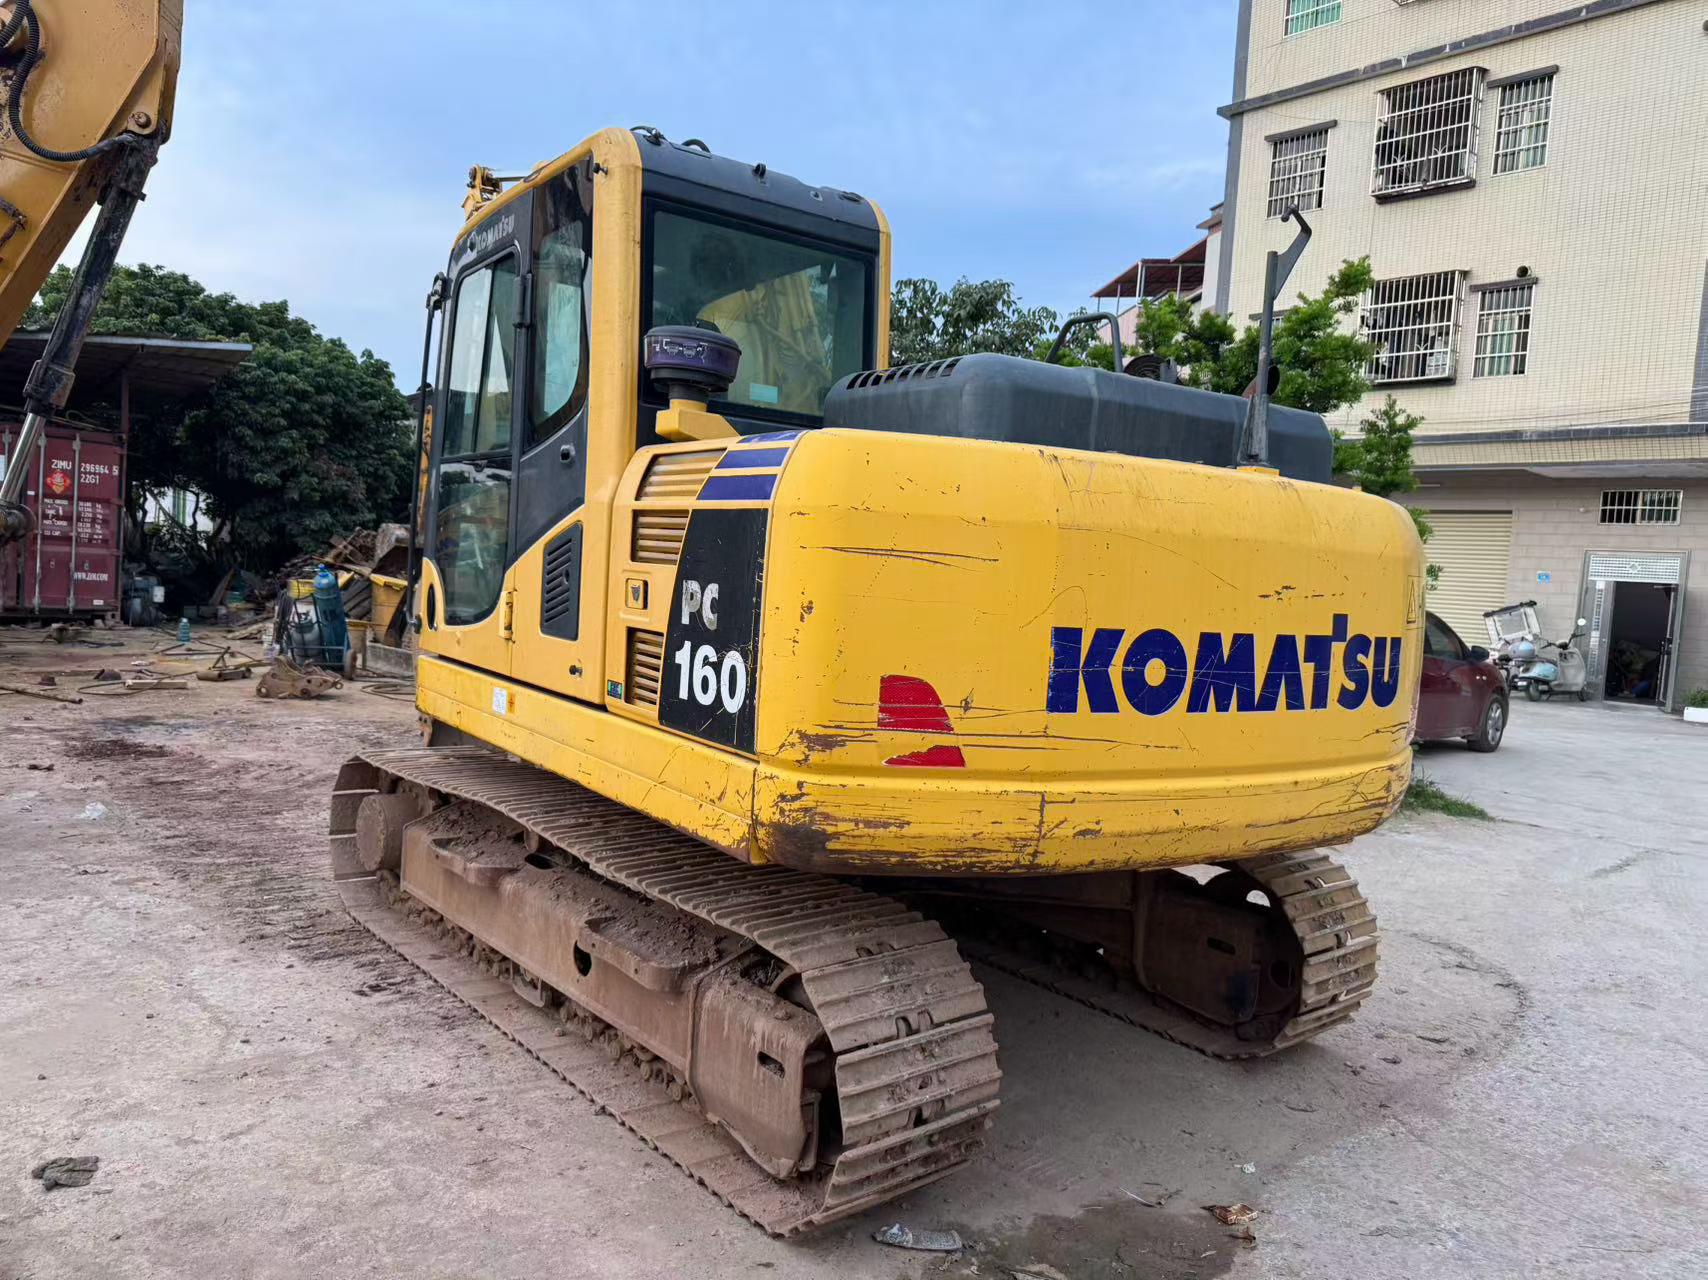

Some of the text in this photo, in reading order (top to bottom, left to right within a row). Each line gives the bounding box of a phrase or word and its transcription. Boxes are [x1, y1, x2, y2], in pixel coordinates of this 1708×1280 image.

[51, 459, 72, 470] ZIMU
[80, 474, 99, 485] 22G1
[681, 579, 719, 631] PC
[675, 640, 747, 714] 160
[1046, 613, 1402, 716] KOMATSU
